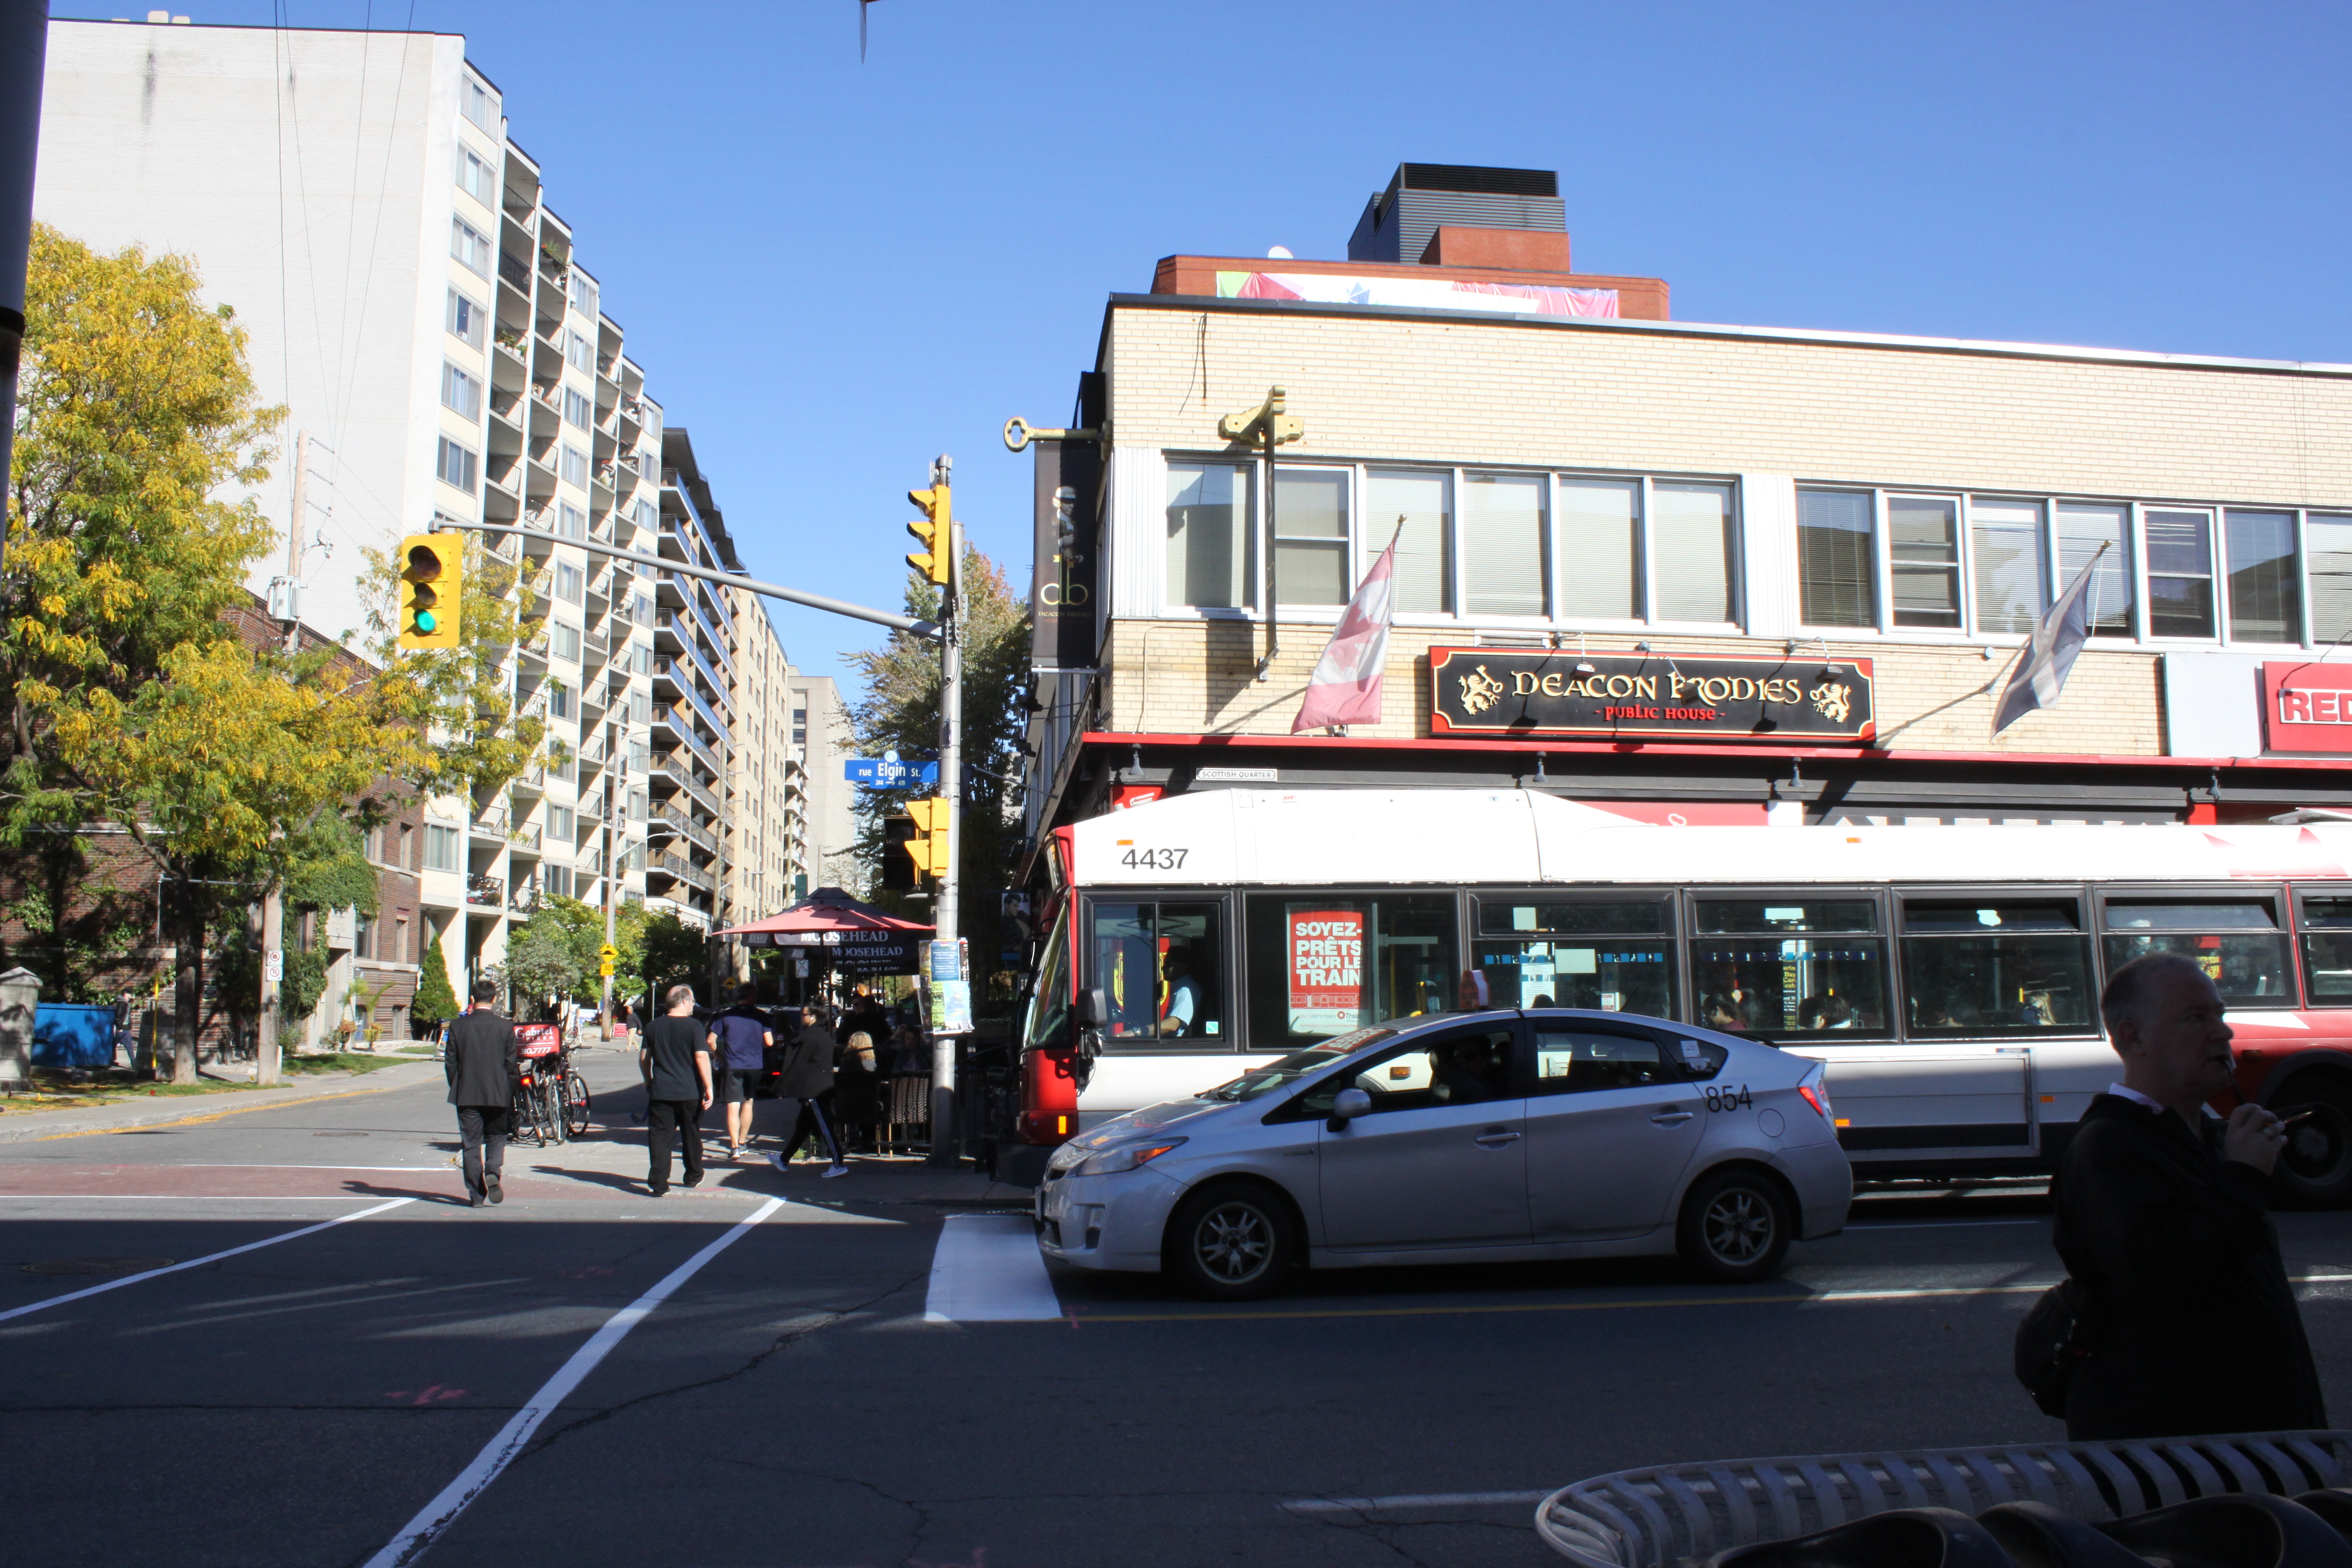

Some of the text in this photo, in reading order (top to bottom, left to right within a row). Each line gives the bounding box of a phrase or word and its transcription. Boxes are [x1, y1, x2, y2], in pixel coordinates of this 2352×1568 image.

[1511, 671, 1803, 706] DEACON BRODIES
[1605, 704, 1716, 721] PUBLIC HOUSE
[878, 762, 906, 780] Elgin
[911, 768, 921, 777] St.
[1121, 848, 1189, 870] 4437
[801, 931, 888, 942] MOOSEHEAD
[1295, 922, 1362, 936] SOYEZ-
[832, 946, 903, 957] MOOSEHEAD
[1296, 936, 1362, 956] PRÊTS
[1296, 956, 1362, 969] POUR LE
[1296, 969, 1363, 986] TRAIN
[515, 1026, 553, 1039] Gabriel
[1706, 1084, 1753, 1113] 854
